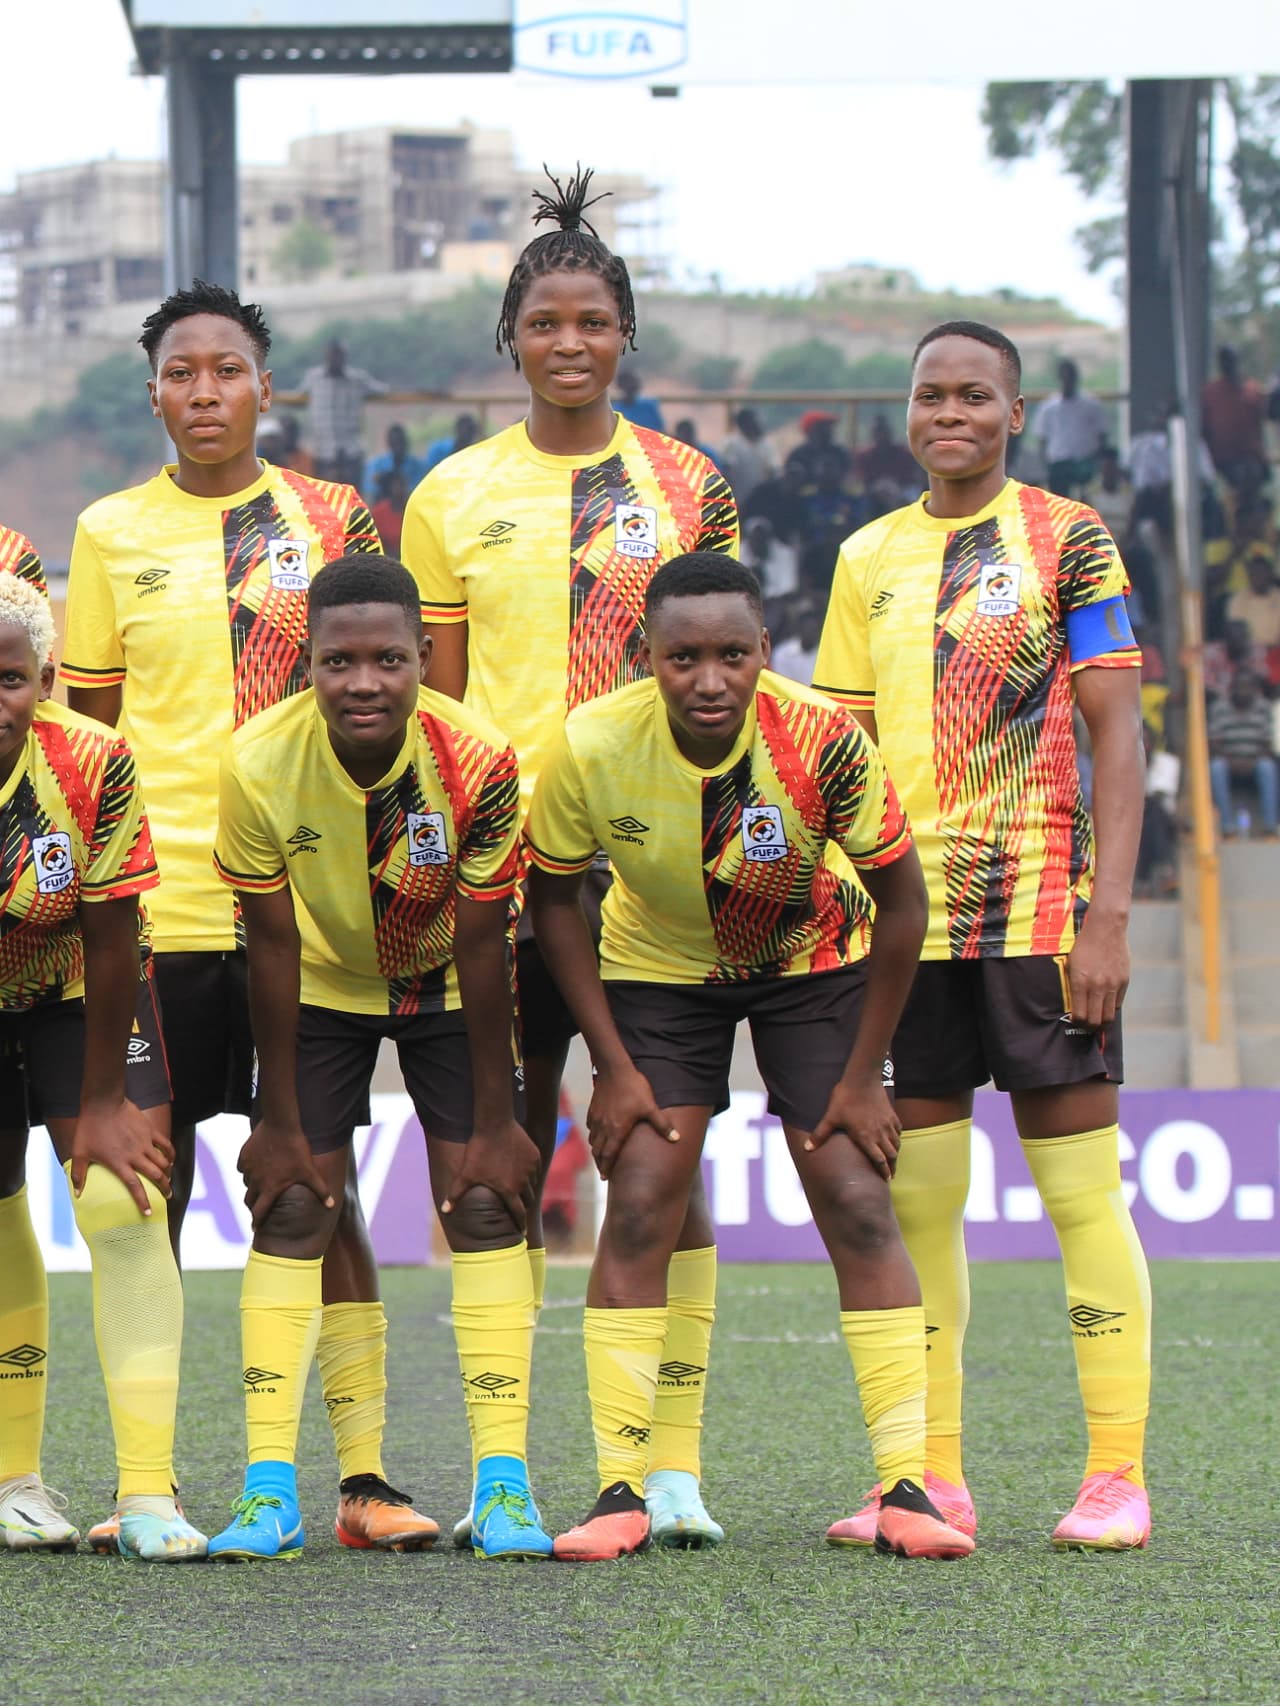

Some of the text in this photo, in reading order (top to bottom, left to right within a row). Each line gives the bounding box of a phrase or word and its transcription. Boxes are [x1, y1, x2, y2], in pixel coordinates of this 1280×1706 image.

[547, 31, 654, 56] FUFA
[481, 537, 513, 550] umbro
[623, 542, 650, 554] FUFA
[278, 577, 304, 587] FUFA
[137, 583, 167, 599] umbro
[983, 603, 1011, 612] FUFA
[610, 832, 645, 847] umbro
[288, 843, 318, 858] umbro
[752, 847, 781, 858] FUFA
[415, 853, 442, 864] FUFA
[45, 874, 71, 889] FUFA
[126, 1054, 151, 1065] mbro
[474, 1390, 517, 1400] umbro
